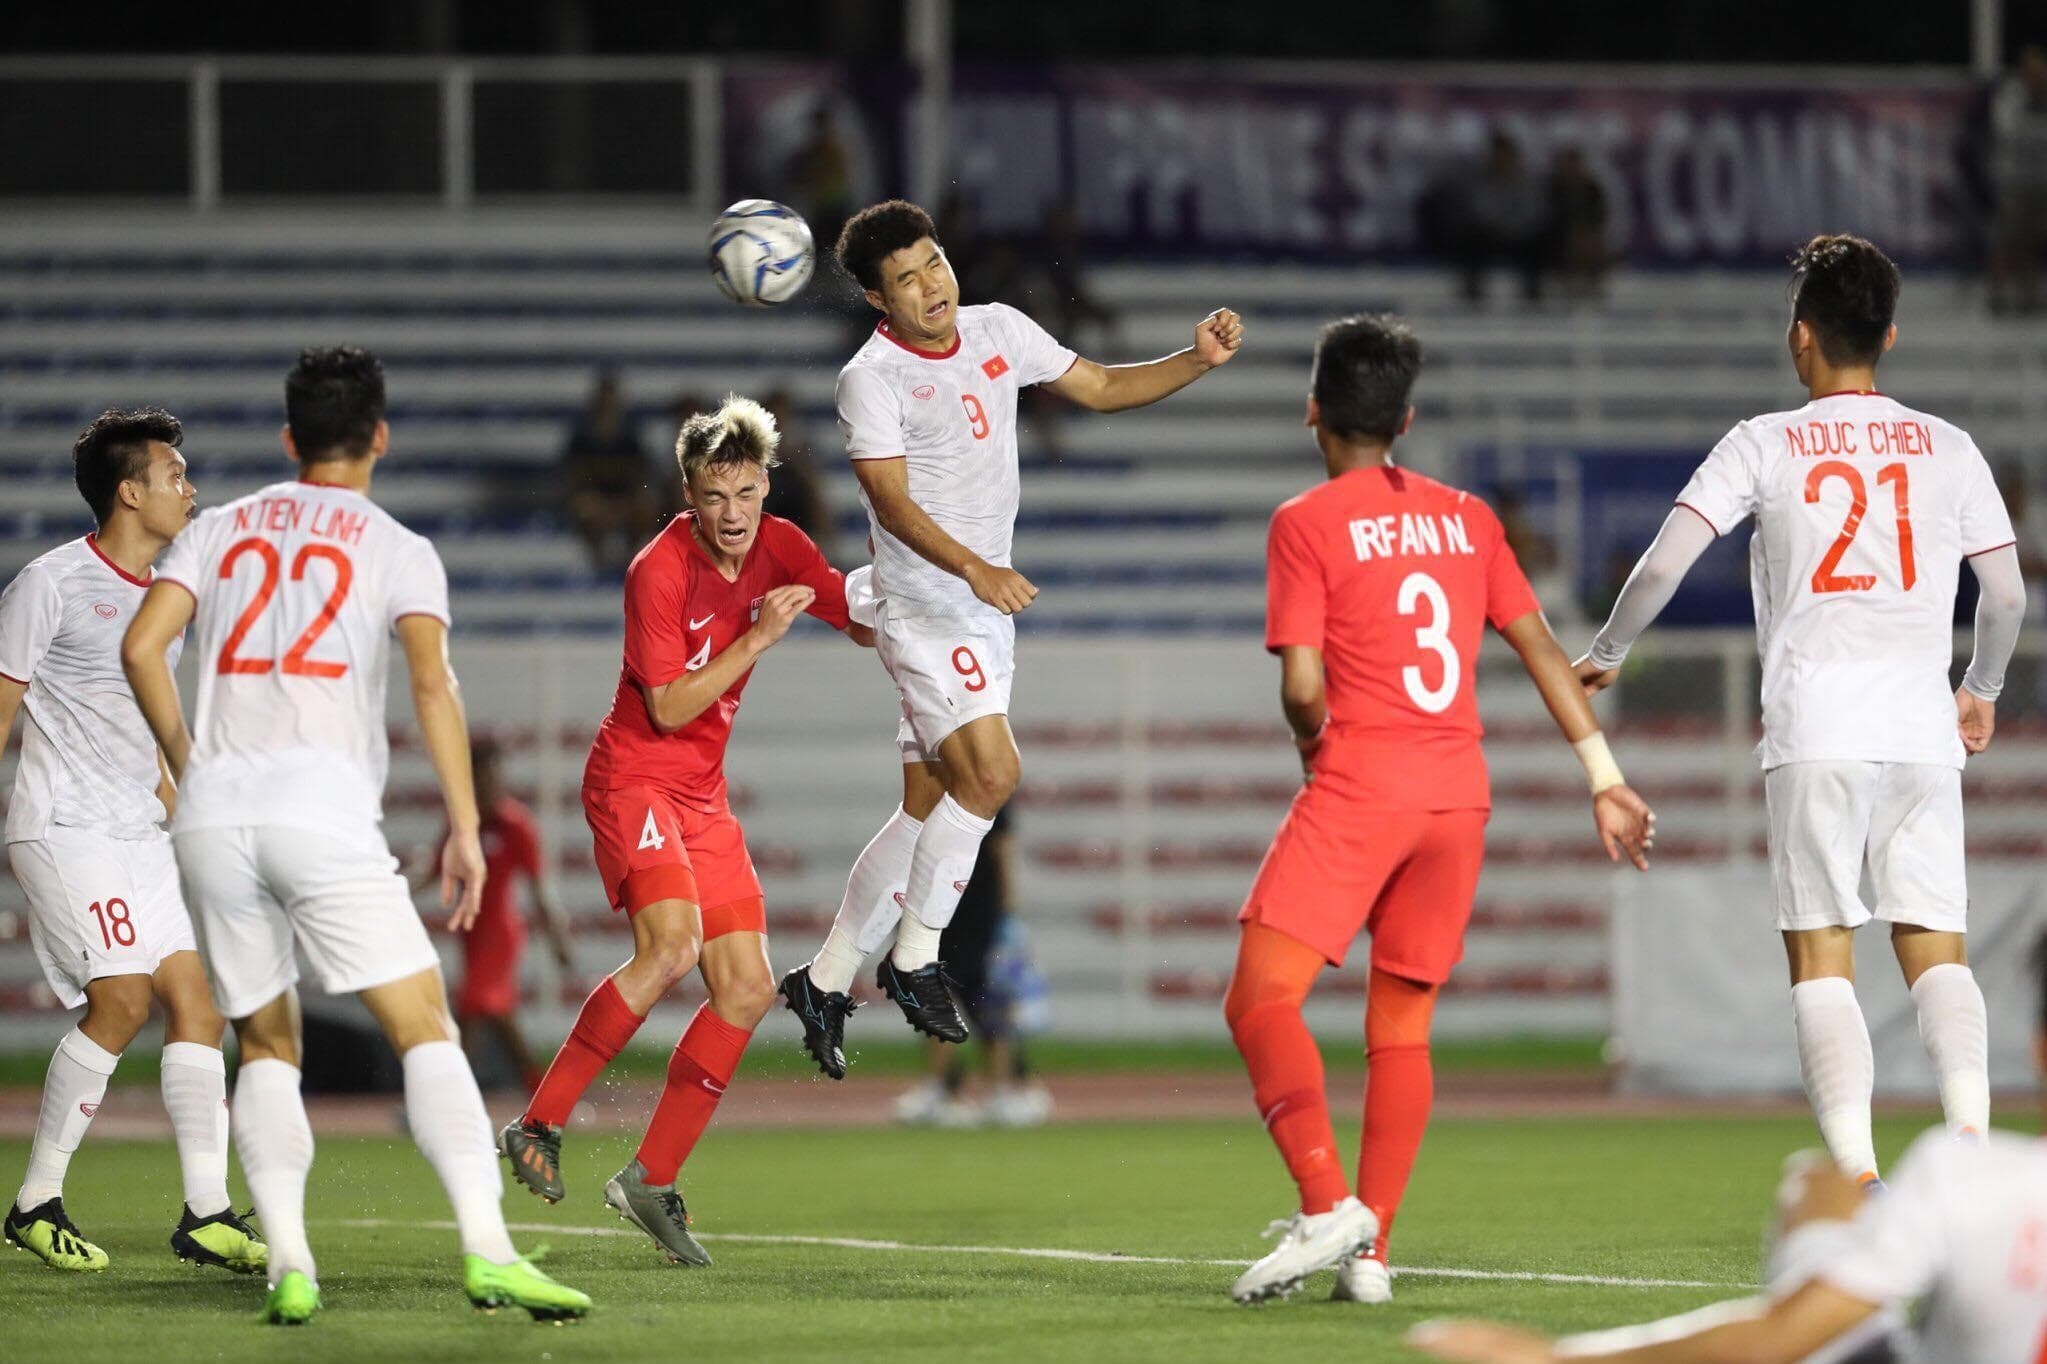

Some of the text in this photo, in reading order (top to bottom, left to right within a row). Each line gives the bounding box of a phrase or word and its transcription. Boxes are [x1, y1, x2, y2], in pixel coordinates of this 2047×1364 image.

[961, 393, 990, 440] 9
[1786, 421, 1934, 458] N.DUC CHIEN
[310, 503, 369, 546] LINH
[1349, 512, 1475, 562] IRFAN N.
[1804, 460, 1917, 594] 21
[216, 536, 353, 679] 22
[685, 635, 711, 671] 4
[1396, 571, 1461, 714] 3
[951, 645, 987, 693] 9
[636, 805, 666, 851] 4
[88, 896, 136, 951] 18
